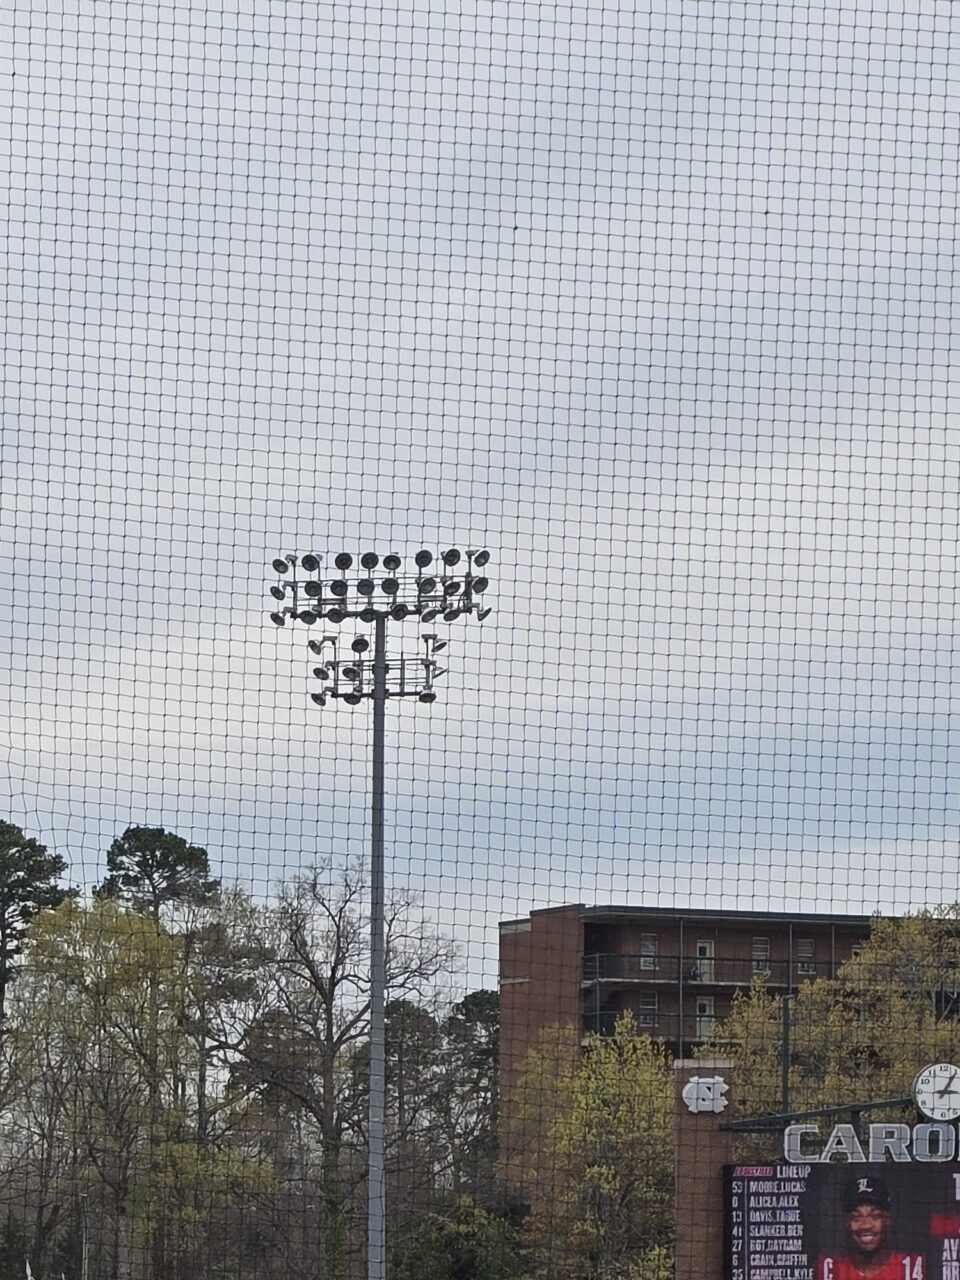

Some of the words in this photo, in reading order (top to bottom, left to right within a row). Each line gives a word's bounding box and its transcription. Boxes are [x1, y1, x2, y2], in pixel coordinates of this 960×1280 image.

[784, 1123, 960, 1163] CARO
[776, 1165, 811, 1178] LINEUP
[732, 1181, 743, 1193] 53
[732, 1196, 738, 1208] 0
[732, 1210, 742, 1223] 13
[732, 1225, 742, 1237] 41
[732, 1240, 742, 1252] 27
[942, 1239, 960, 1260] AV
[732, 1254, 738, 1266] 6
[732, 1269, 743, 1280] 35
